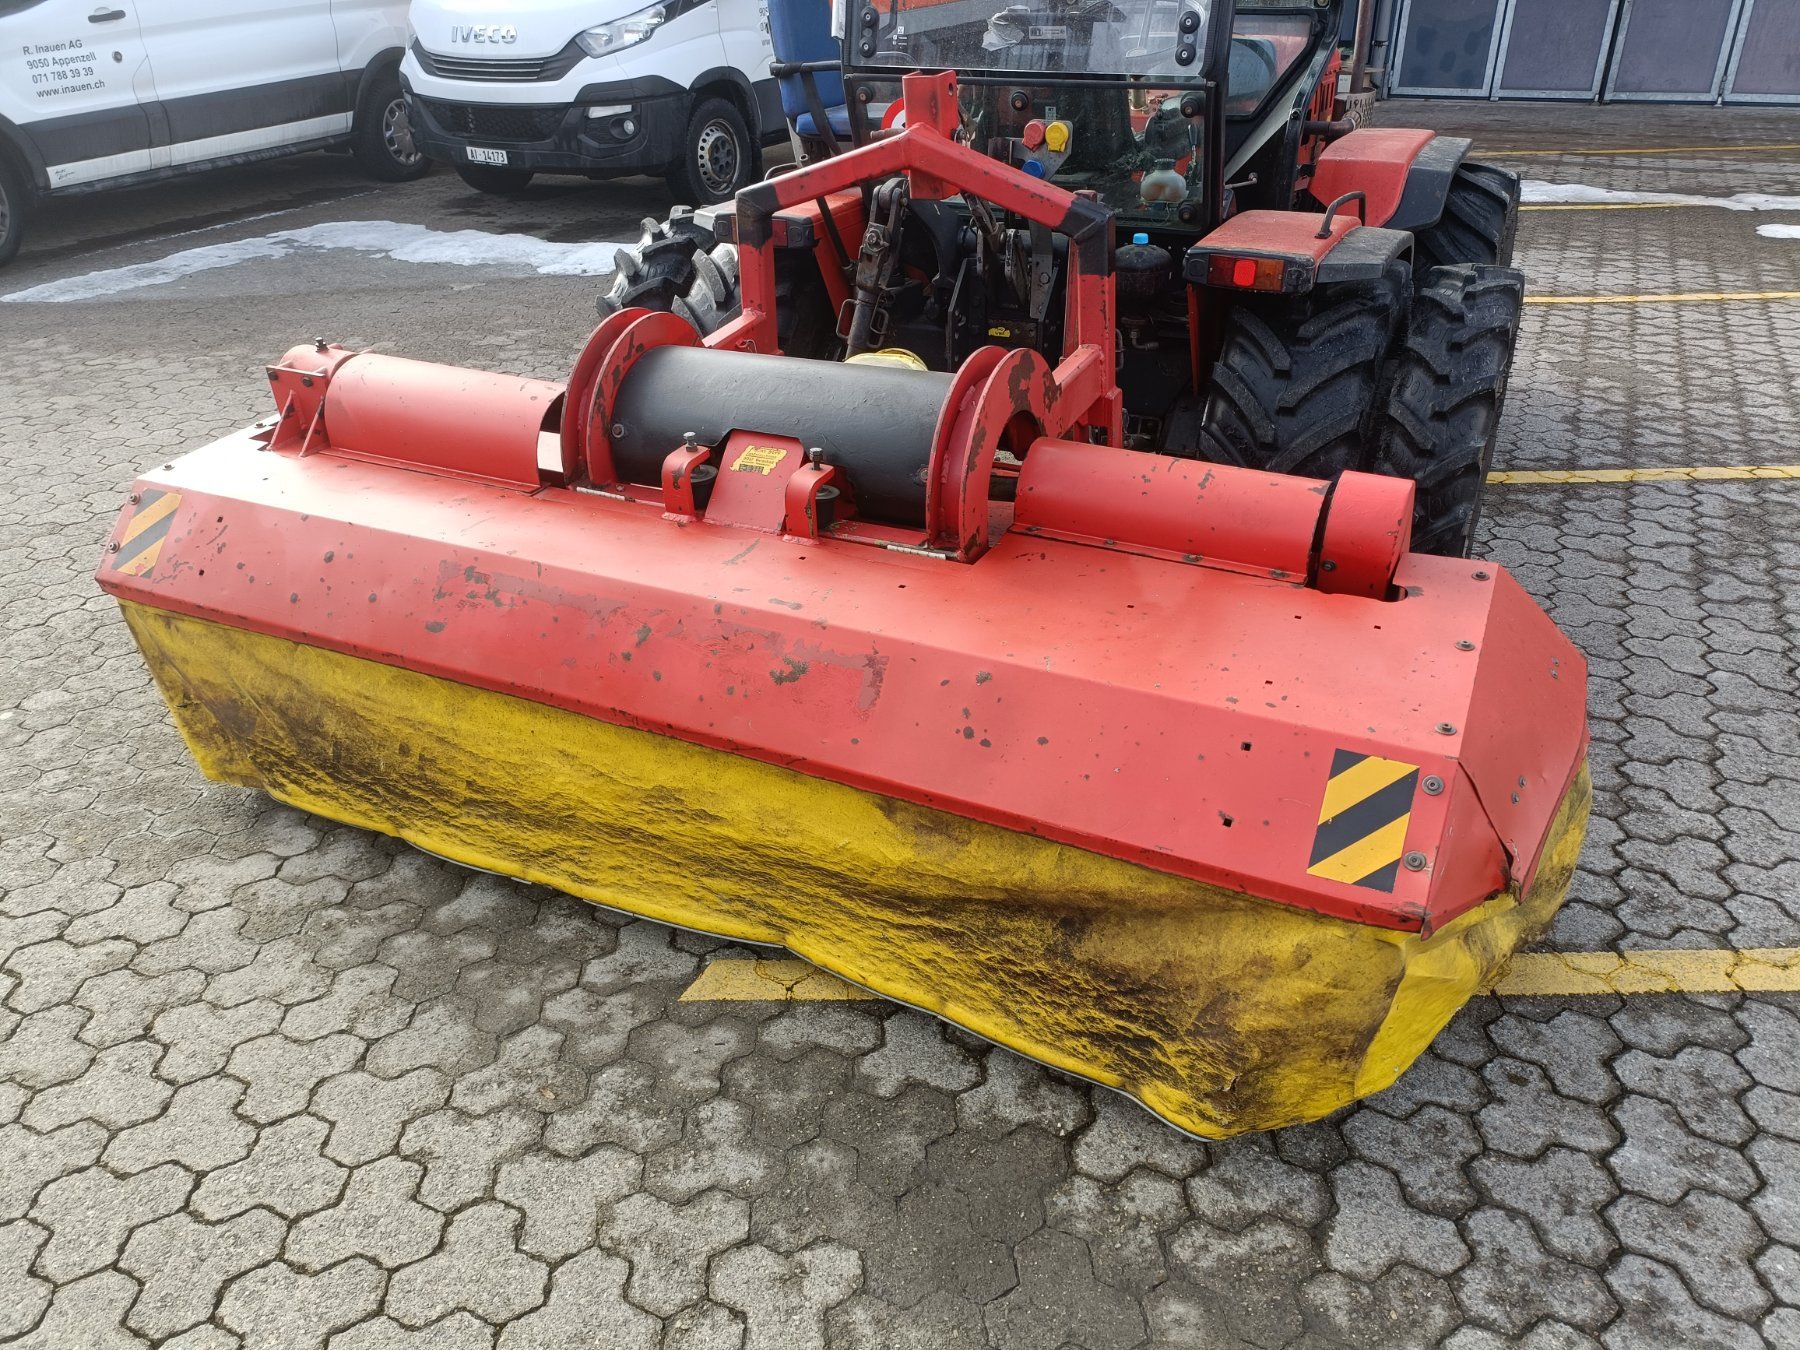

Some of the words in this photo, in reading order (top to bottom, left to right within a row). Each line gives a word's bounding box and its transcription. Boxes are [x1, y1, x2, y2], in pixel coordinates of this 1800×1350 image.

[451, 24, 518, 44] IVECO
[22, 45, 33, 56] R.
[35, 42, 67, 55] Inauen
[68, 39, 83, 50] AG
[26, 58, 50, 70] 9050
[52, 51, 97, 68] Appenzell
[31, 72, 49, 84] 071
[51, 70, 68, 81] 788
[69, 68, 81, 78] 39
[83, 66, 94, 77] 39
[36, 80, 106, 98] www.inauen.ch
